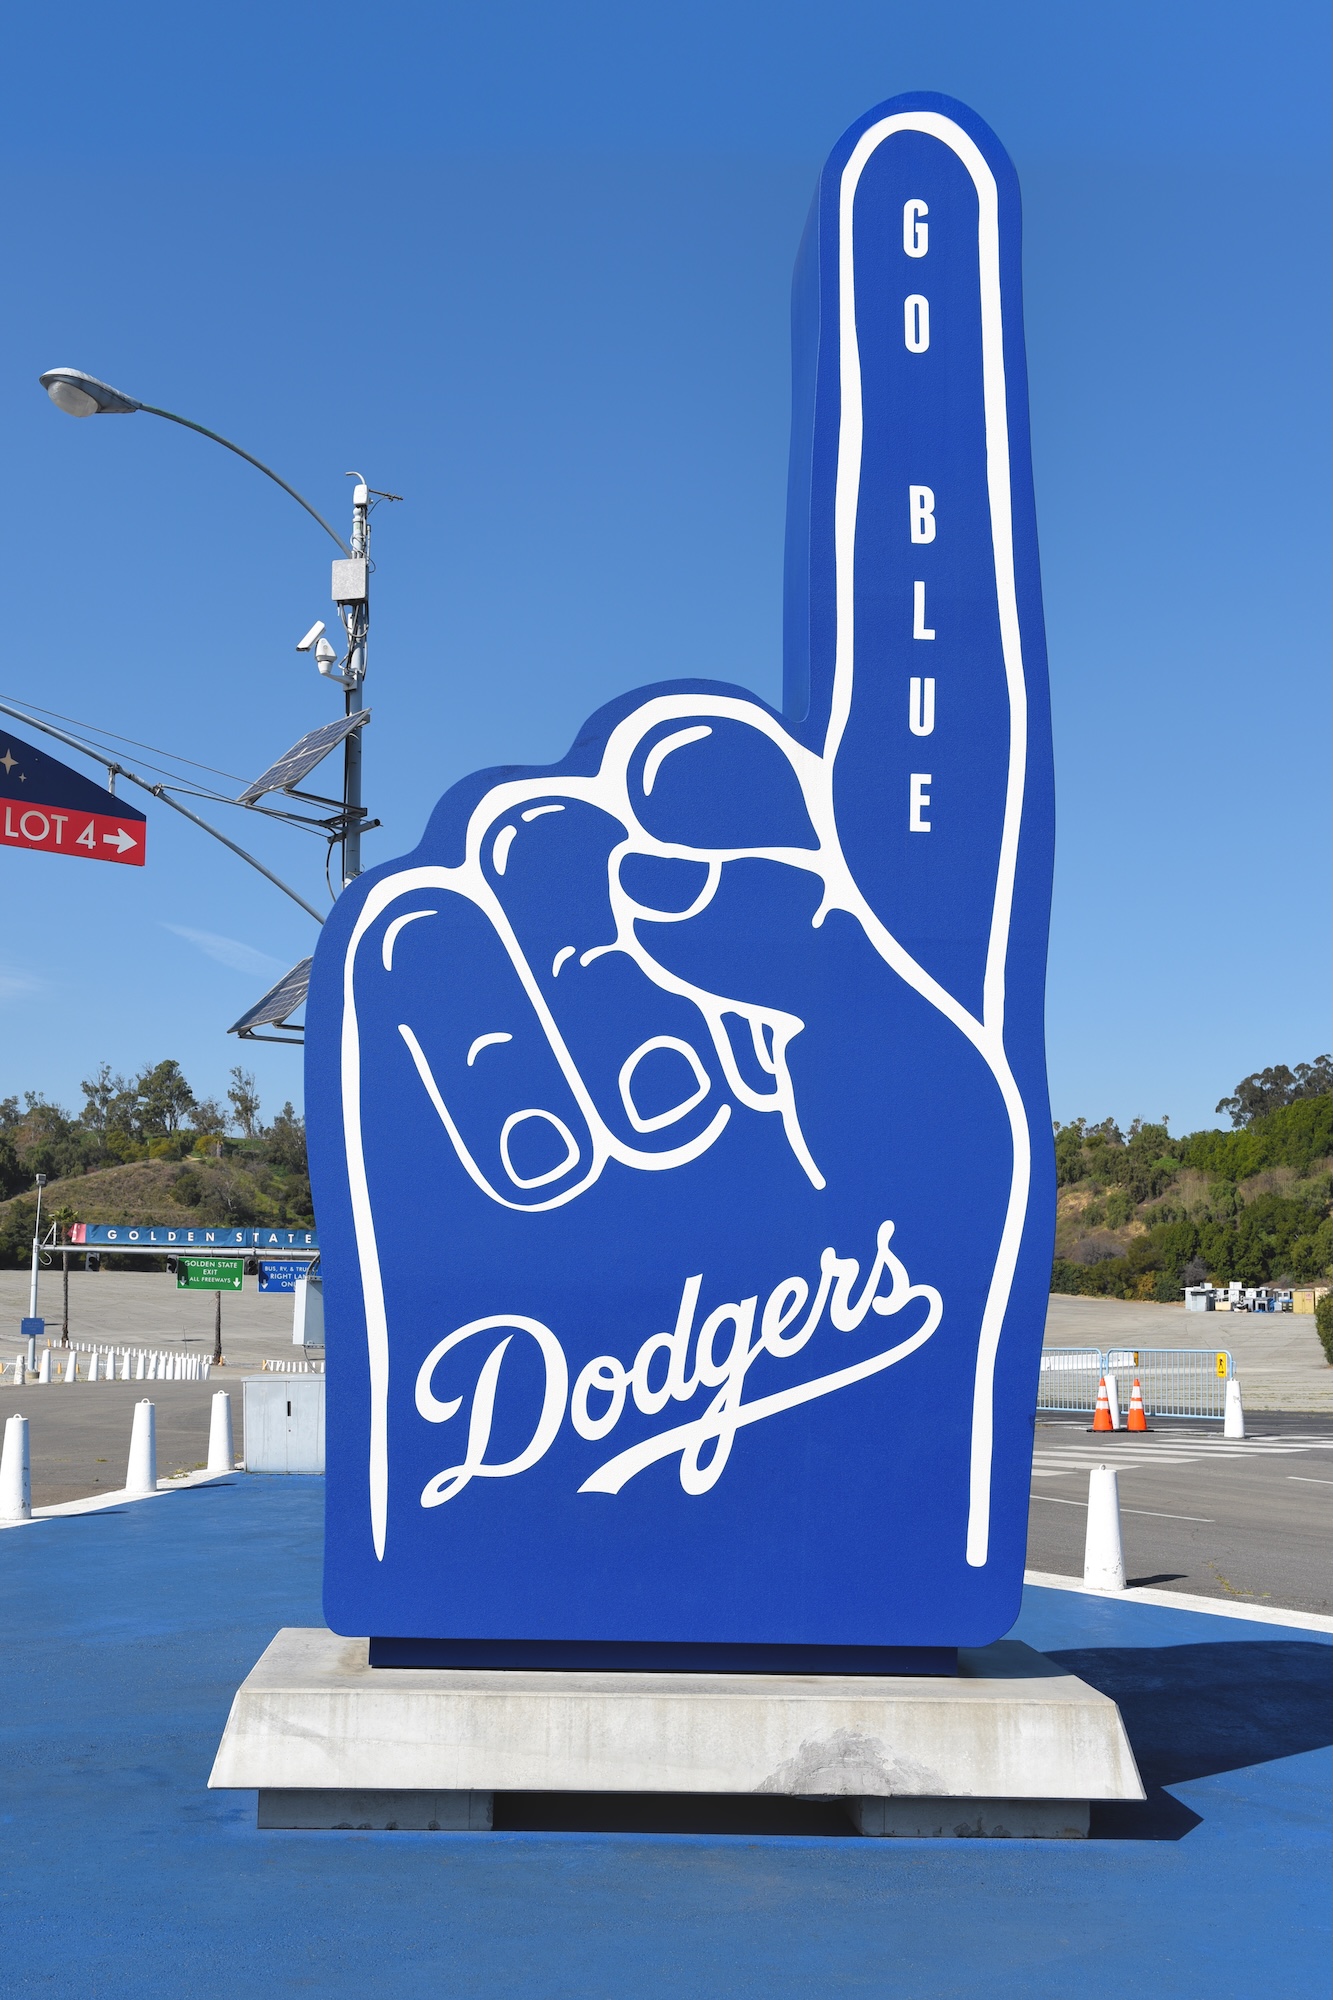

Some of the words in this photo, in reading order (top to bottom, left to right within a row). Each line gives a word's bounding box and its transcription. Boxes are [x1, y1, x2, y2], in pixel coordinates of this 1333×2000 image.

[903, 198, 930, 354] GO
[909, 484, 937, 833] BLUE
[5, 806, 69, 845] LOT
[75, 819, 97, 850] 4
[107, 1229, 215, 1243] GOLDEN
[235, 1232, 312, 1244] STATE
[184, 1260, 216, 1268] GOLDEN
[217, 1261, 238, 1269] STATE
[201, 1276, 231, 1284] FREEWAYS
[414, 1219, 944, 1509] Dodgers
